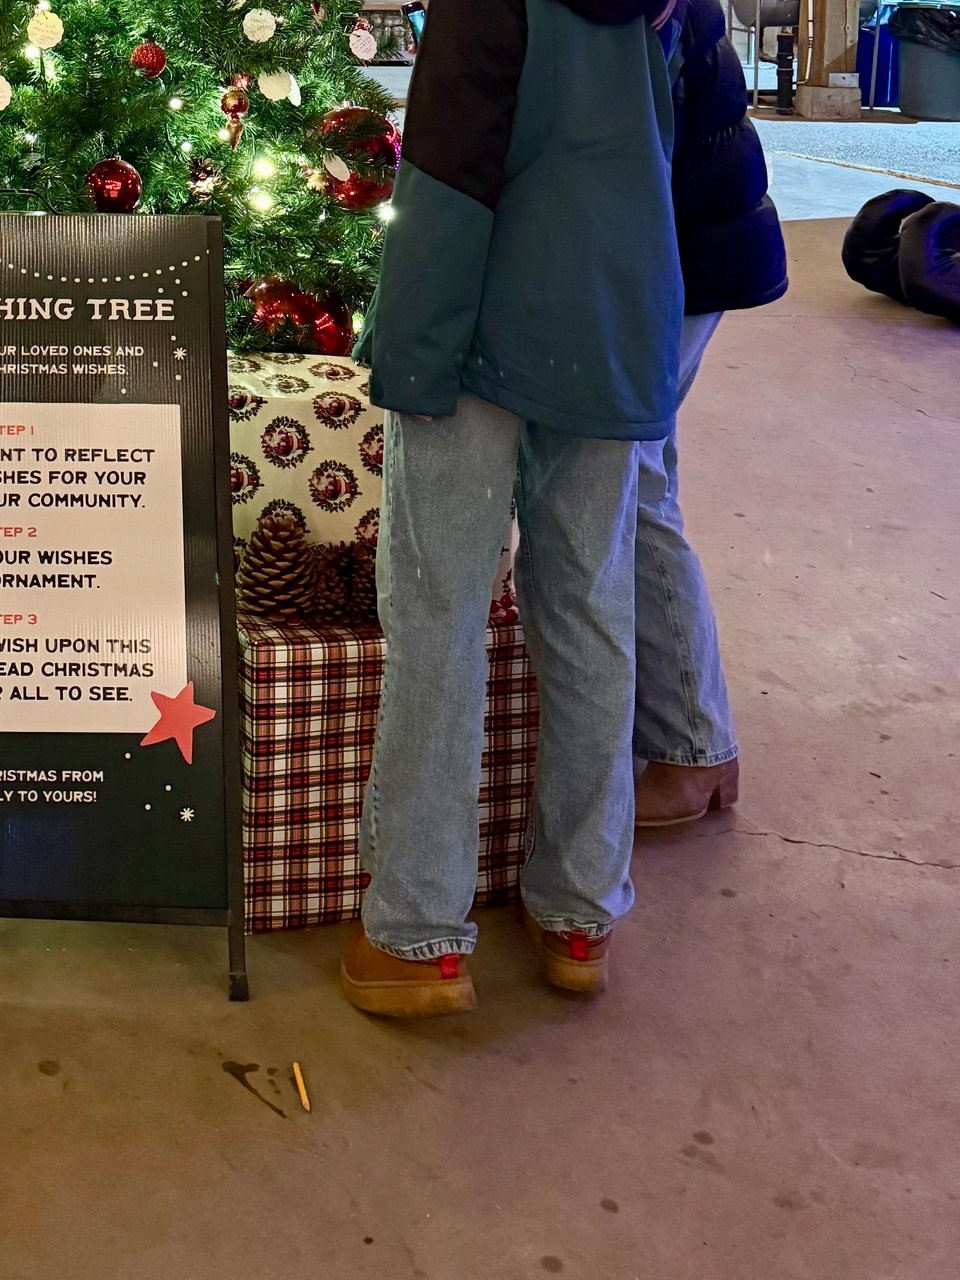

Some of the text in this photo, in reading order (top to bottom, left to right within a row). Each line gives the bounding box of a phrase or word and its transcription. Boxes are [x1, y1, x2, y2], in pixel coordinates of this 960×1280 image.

[86, 298, 175, 321] TREE
[21, 345, 69, 356] LOVED
[73, 345, 111, 356] ONES
[115, 346, 145, 357] AND
[72, 363, 129, 375] WISHES.
[32, 448, 58, 462] TO
[64, 448, 155, 463] REFLECT
[48, 470, 87, 484] FOR
[94, 471, 147, 485] YOUR
[28, 493, 146, 508] COMMUNITY.
[27, 527, 37, 537] 2
[37, 550, 113, 565] WISHES
[27, 614, 38, 625] 3
[45, 638, 100, 653] UPON
[106, 639, 152, 654] THIS
[41, 662, 154, 678] CHRISTMAS
[9, 686, 49, 701] ALL
[55, 686, 82, 701] TO
[89, 686, 133, 702] SEE.
[62, 770, 104, 782] FROM
[17, 790, 38, 802] TO
[43, 790, 97, 803] YOURS!
